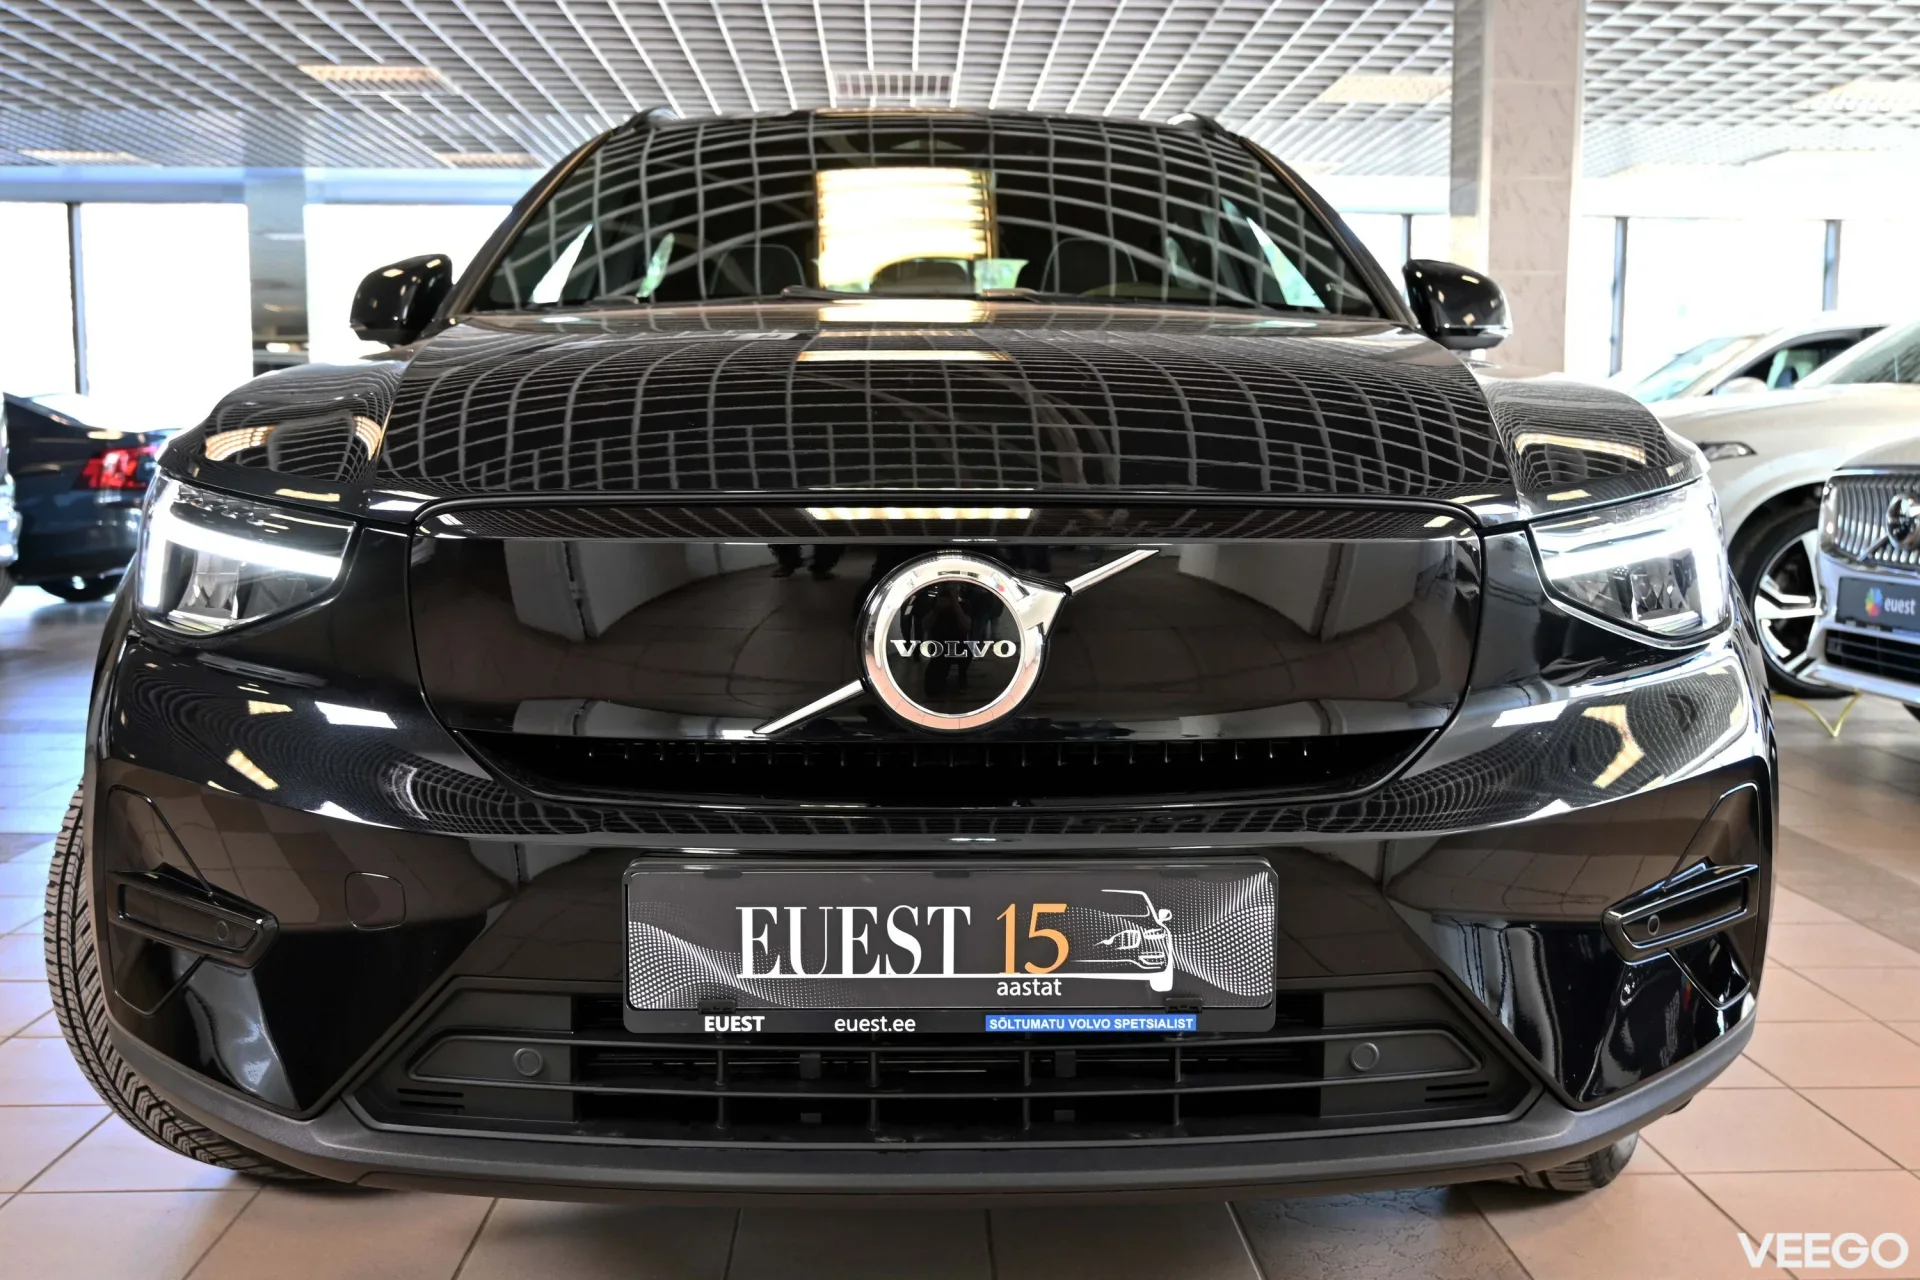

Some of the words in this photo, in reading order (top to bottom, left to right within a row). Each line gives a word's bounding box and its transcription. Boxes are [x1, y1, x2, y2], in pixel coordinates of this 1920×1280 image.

[1884, 597, 1916, 616] euest
[890, 639, 1017, 658] VOLVO
[736, 905, 971, 978] EUEST
[997, 903, 1070, 974] 15
[996, 978, 1062, 996] aastat
[704, 1015, 765, 1032] EUEST
[834, 1015, 916, 1032] euest.ee
[989, 1017, 1065, 1030] SÕLTUMATU
[1068, 1018, 1111, 1030] VOLVO
[1113, 1018, 1194, 1030] SPETSIALIST
